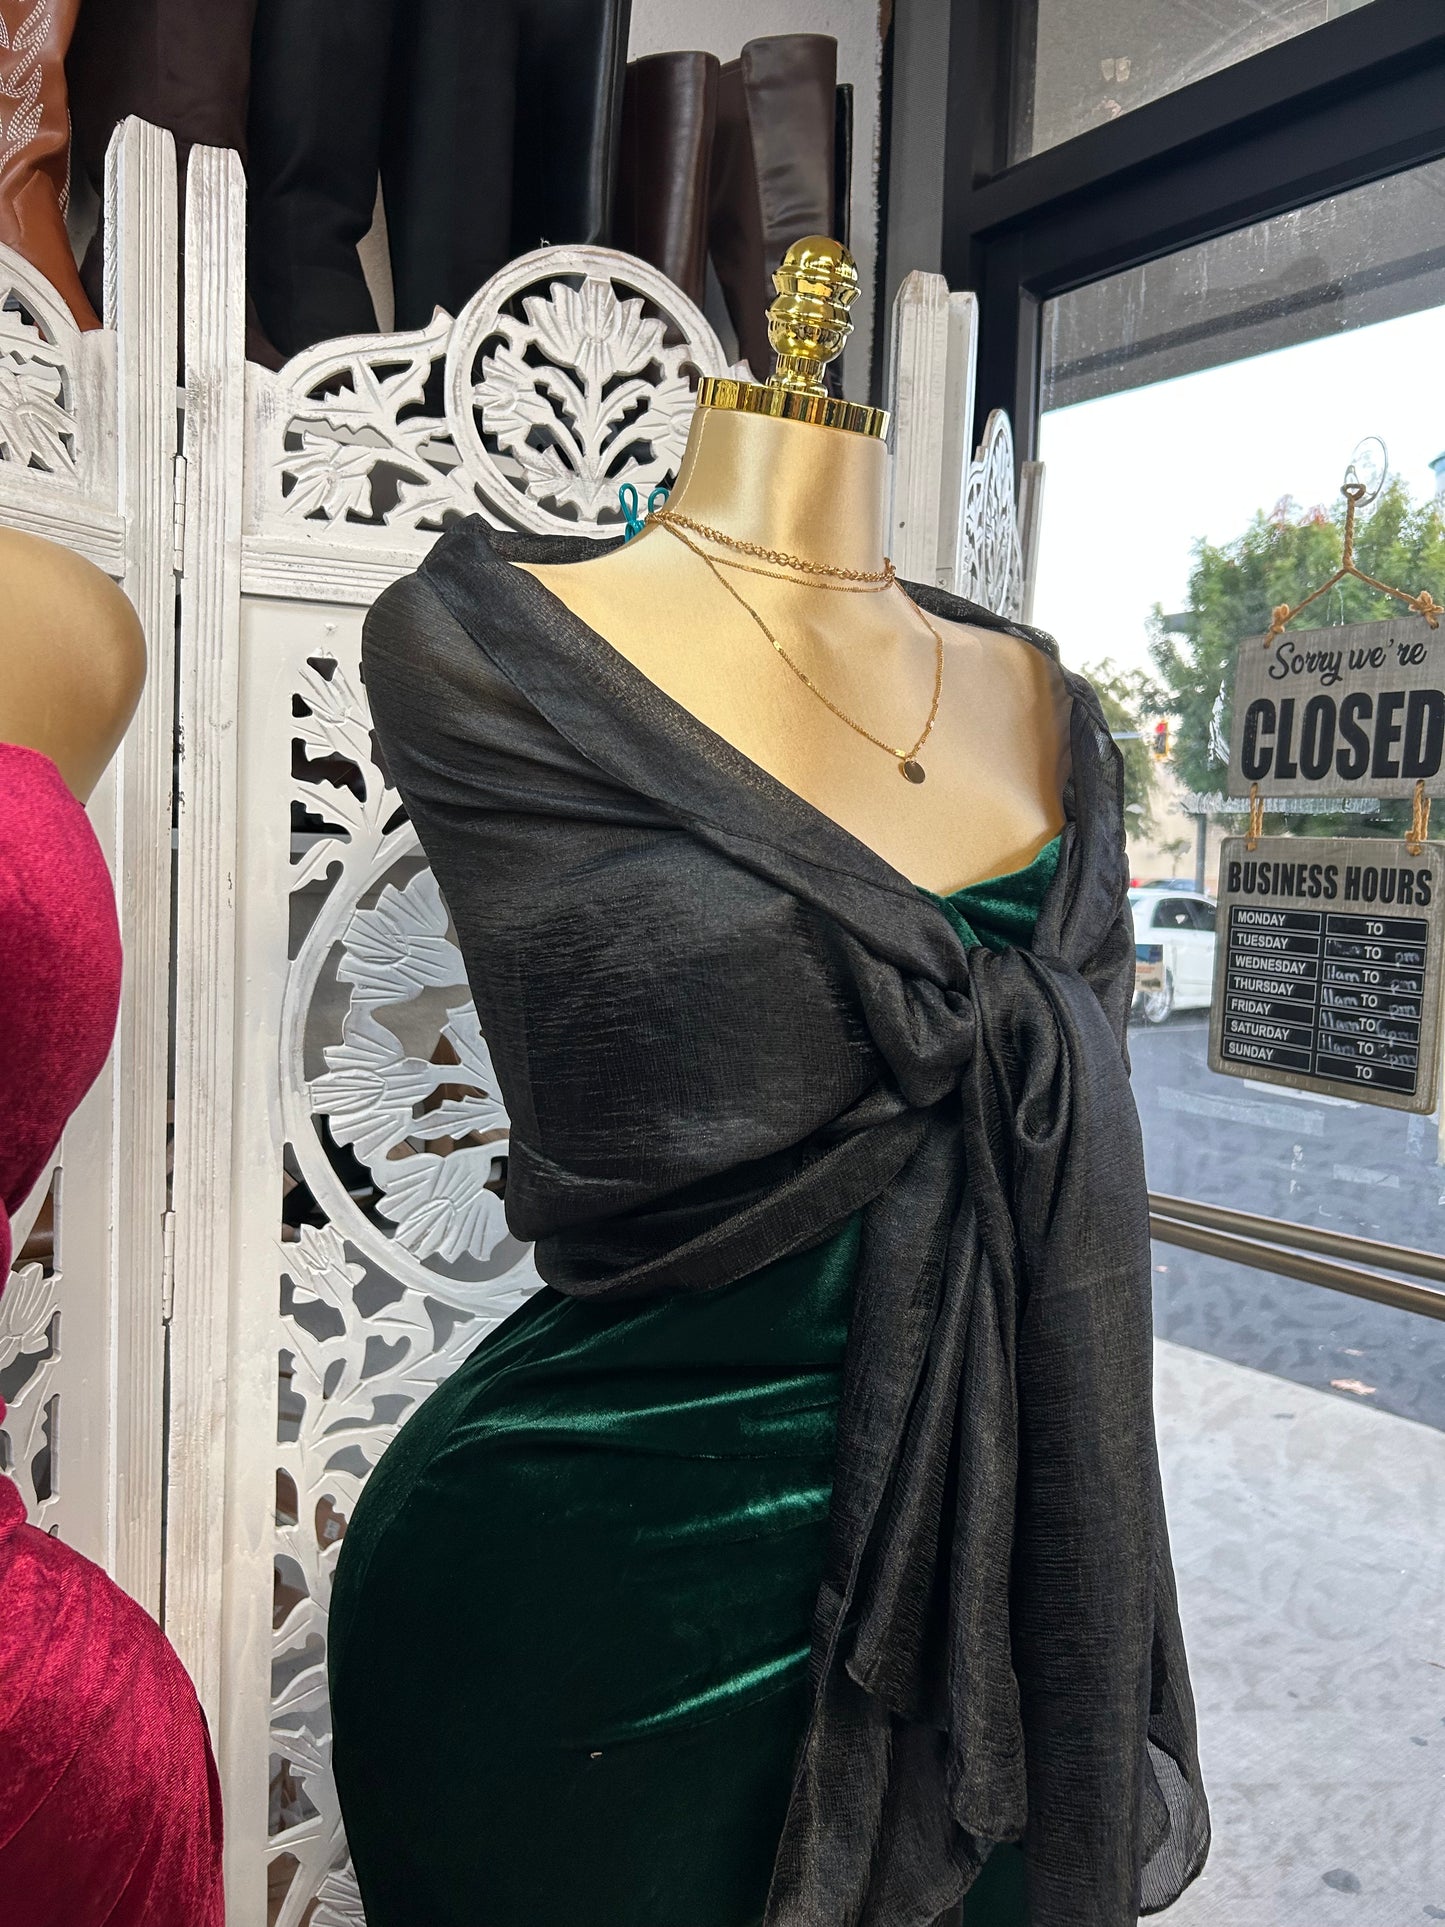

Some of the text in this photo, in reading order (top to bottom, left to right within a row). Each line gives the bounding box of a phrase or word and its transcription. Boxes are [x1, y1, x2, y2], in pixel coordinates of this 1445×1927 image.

[1268, 638, 1427, 686] Sorry we're
[1241, 689, 1445, 781] CLOSED
[1227, 861, 1433, 906] BUSINESS HOURS
[1237, 911, 1384, 936] MONDAY TO
[1236, 932, 1289, 950] TUESDAY
[1364, 945, 1382, 960] TO
[1235, 954, 1306, 975] WEDNESDAY
[1362, 969, 1380, 984] TO
[1233, 976, 1295, 996] THURSDAY
[1360, 993, 1378, 1008] TO
[1231, 998, 1272, 1015] FRIDAY
[1358, 1017, 1376, 1032] TO
[1230, 1020, 1290, 1041] SATURDAY
[1356, 1041, 1374, 1056] TO
[1228, 1041, 1373, 1080] SUNDAY TO
